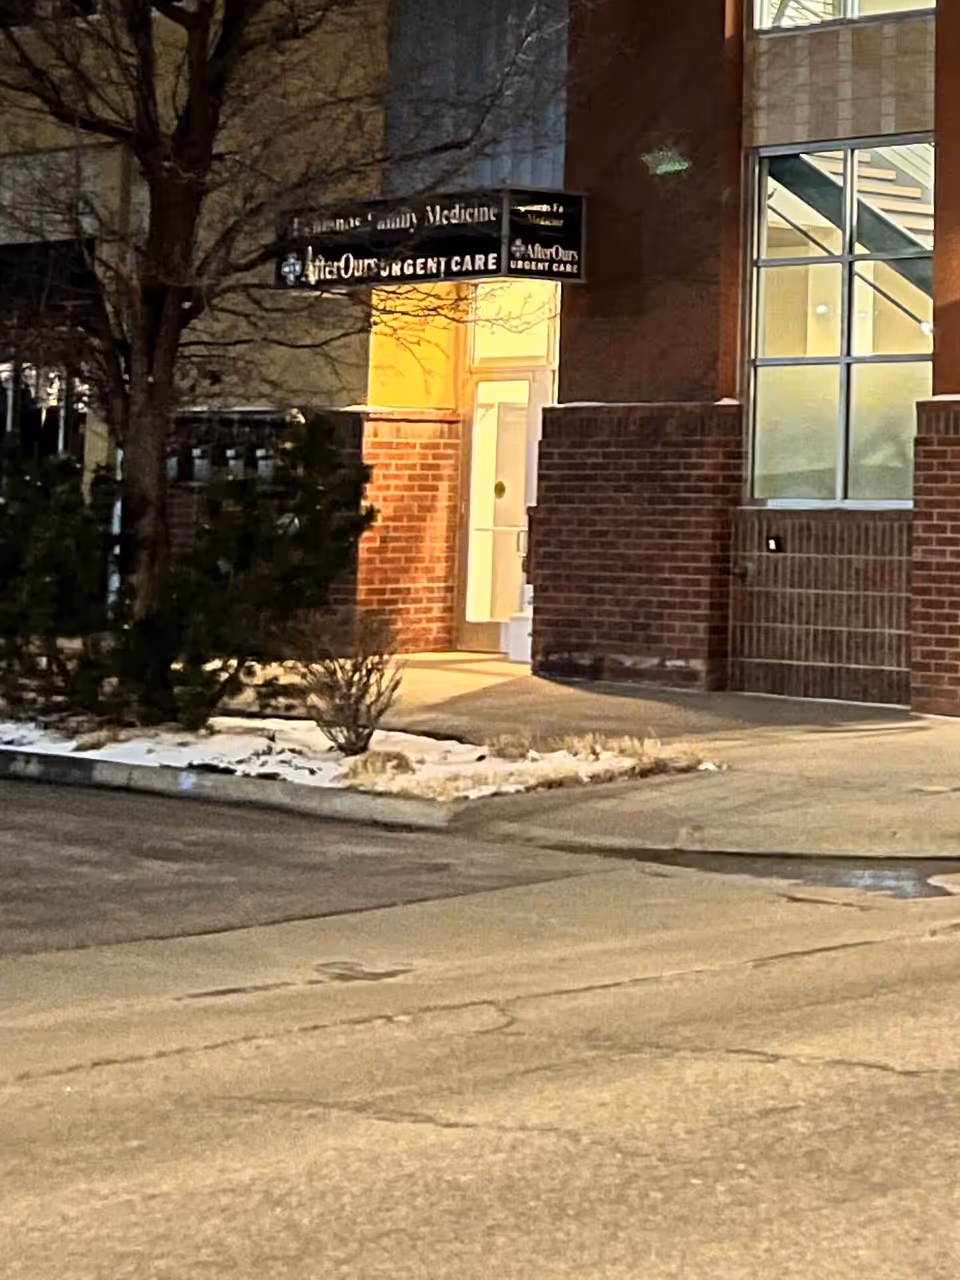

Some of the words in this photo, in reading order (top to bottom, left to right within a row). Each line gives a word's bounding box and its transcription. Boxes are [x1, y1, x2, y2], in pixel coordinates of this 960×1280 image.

[425, 200, 498, 227] Medicine
[451, 252, 498, 272] CARE
[525, 243, 579, 262] AfterOurs
[510, 260, 549, 271] URGENT
[552, 261, 579, 273] CARE
